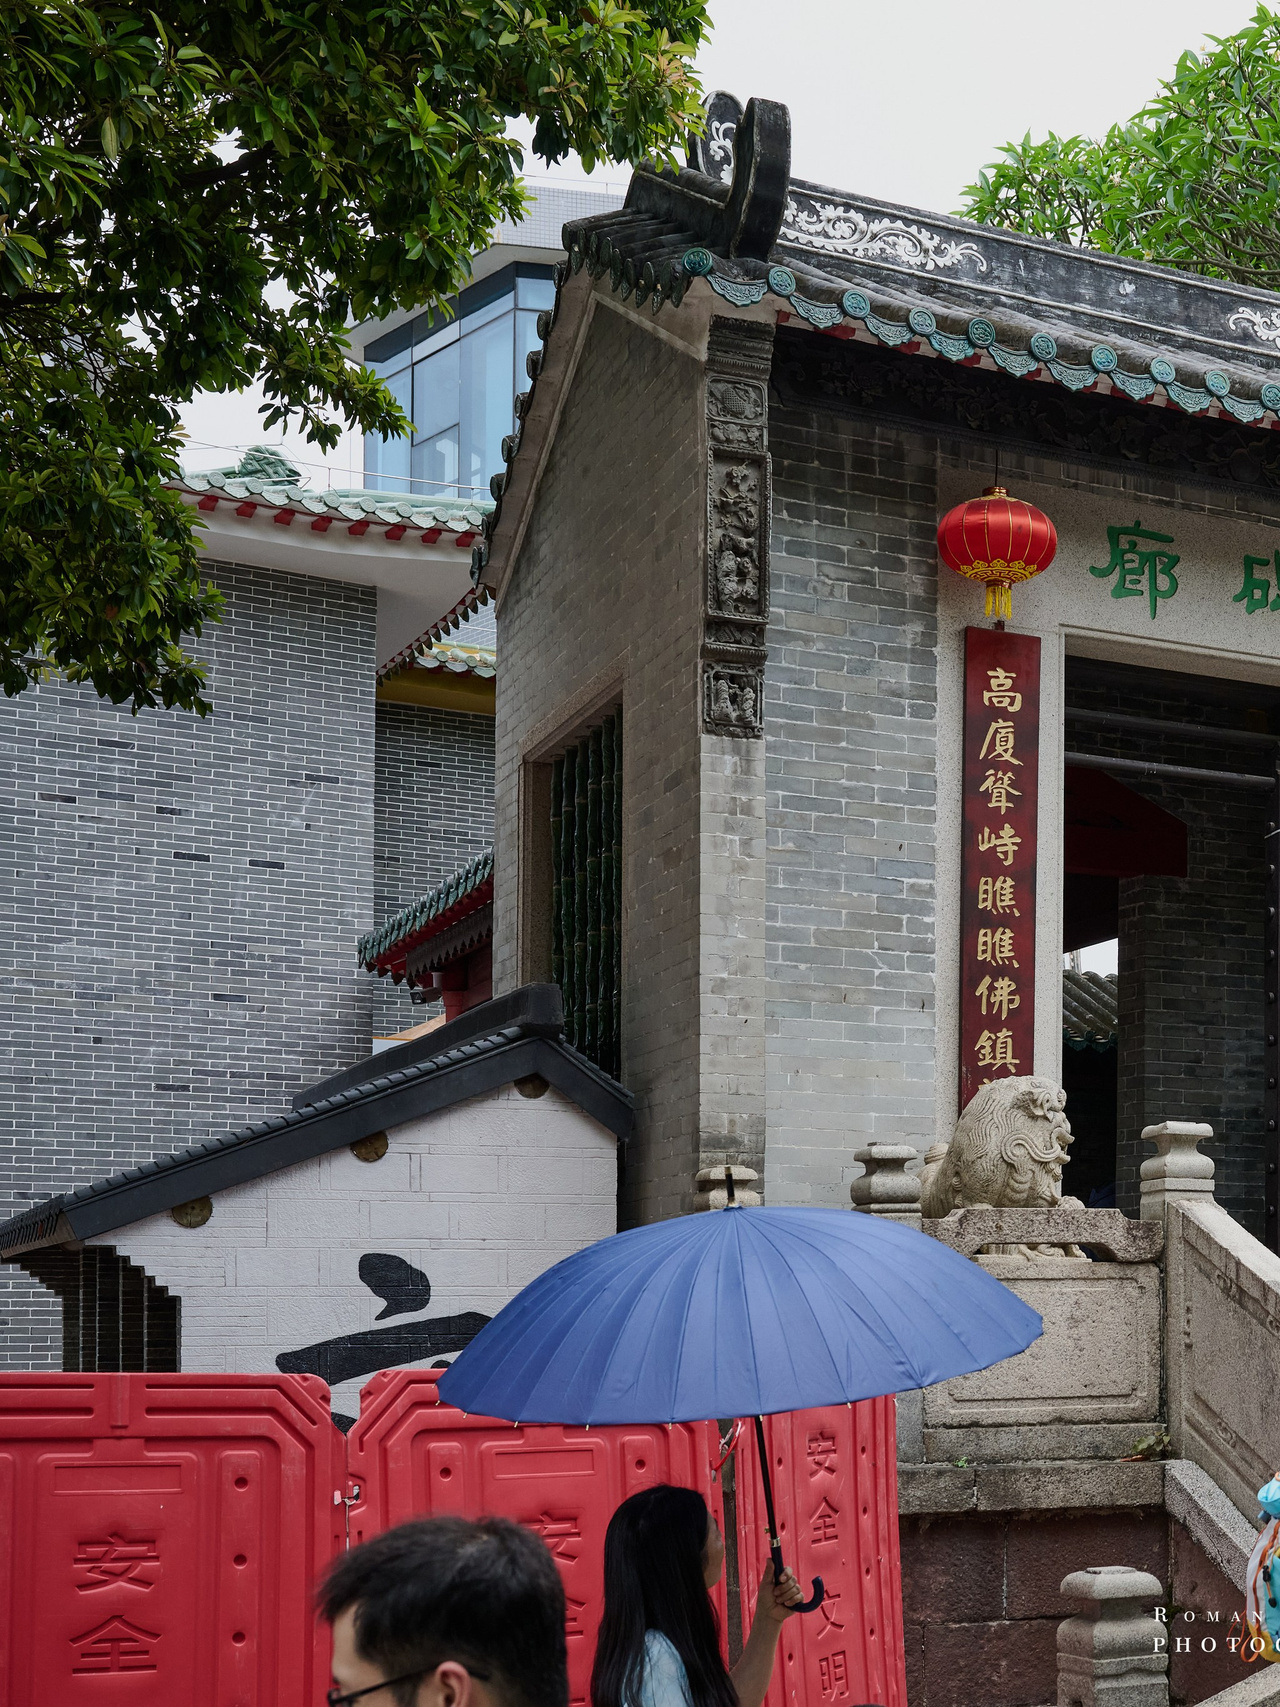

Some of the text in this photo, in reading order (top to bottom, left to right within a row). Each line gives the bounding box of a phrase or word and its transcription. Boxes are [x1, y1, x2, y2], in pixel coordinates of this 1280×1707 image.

[974, 667, 1024, 1091] 高廈聳峙瞧瞧佛鎮
[69, 1533, 163, 1676] 安全
[807, 1431, 850, 1702] 安全文明
